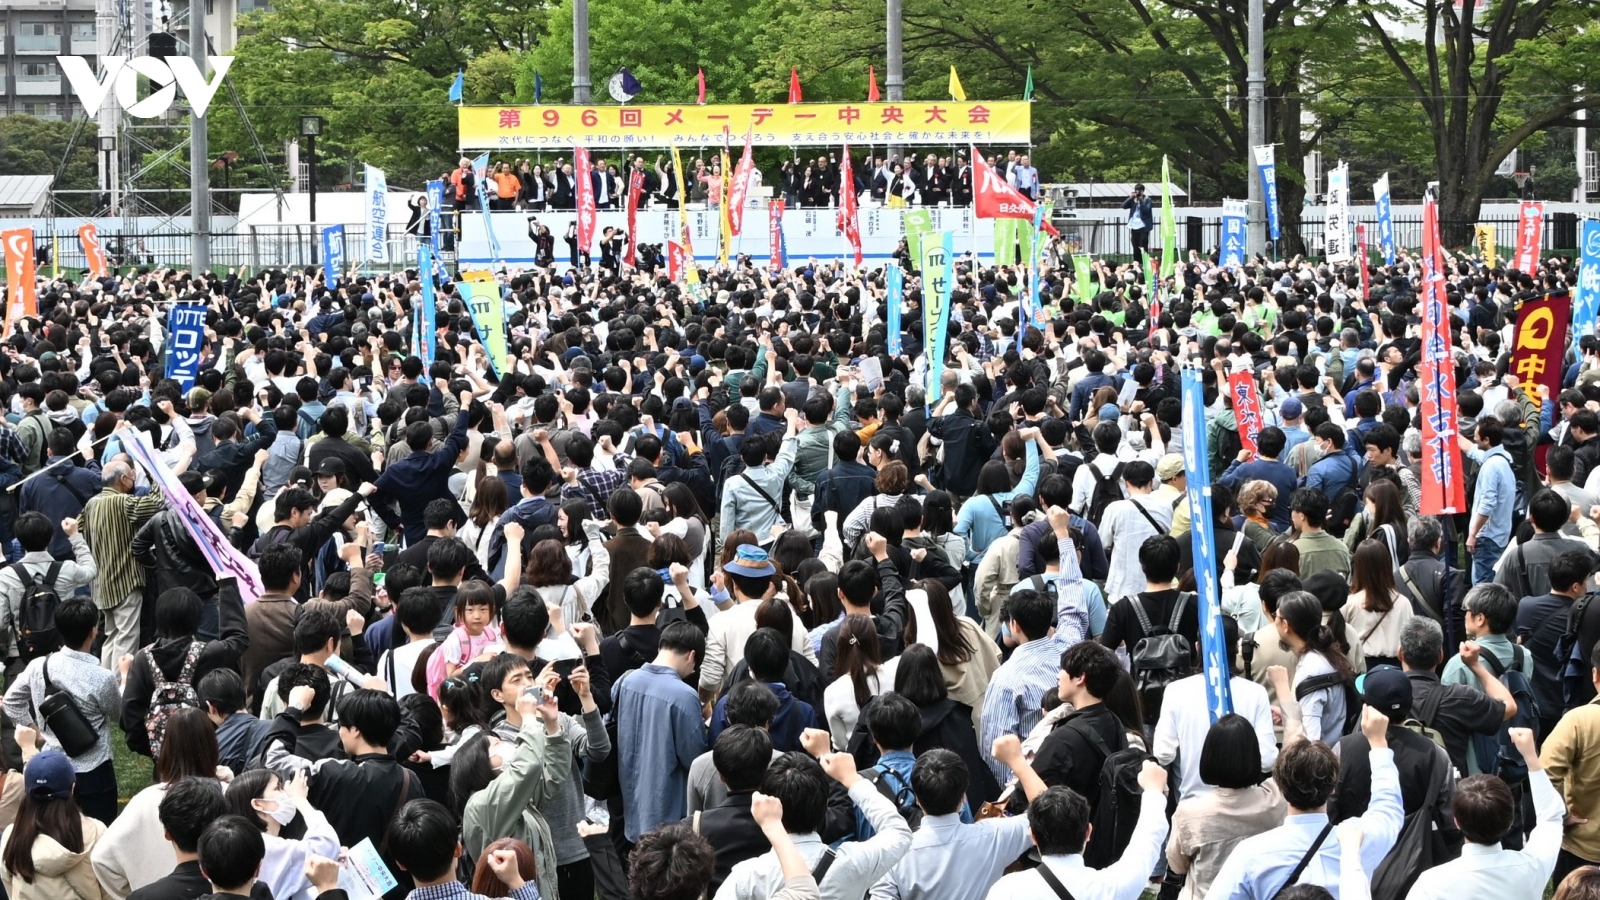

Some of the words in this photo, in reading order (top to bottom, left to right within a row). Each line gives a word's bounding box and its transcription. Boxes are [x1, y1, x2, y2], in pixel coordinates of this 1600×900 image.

[498, 105, 990, 128] 第96回メーデー中央大会
[499, 135, 575, 144] 次代につなぐ
[674, 134, 775, 144] みんなでつくろう
[371, 190, 386, 259] 航空連合
